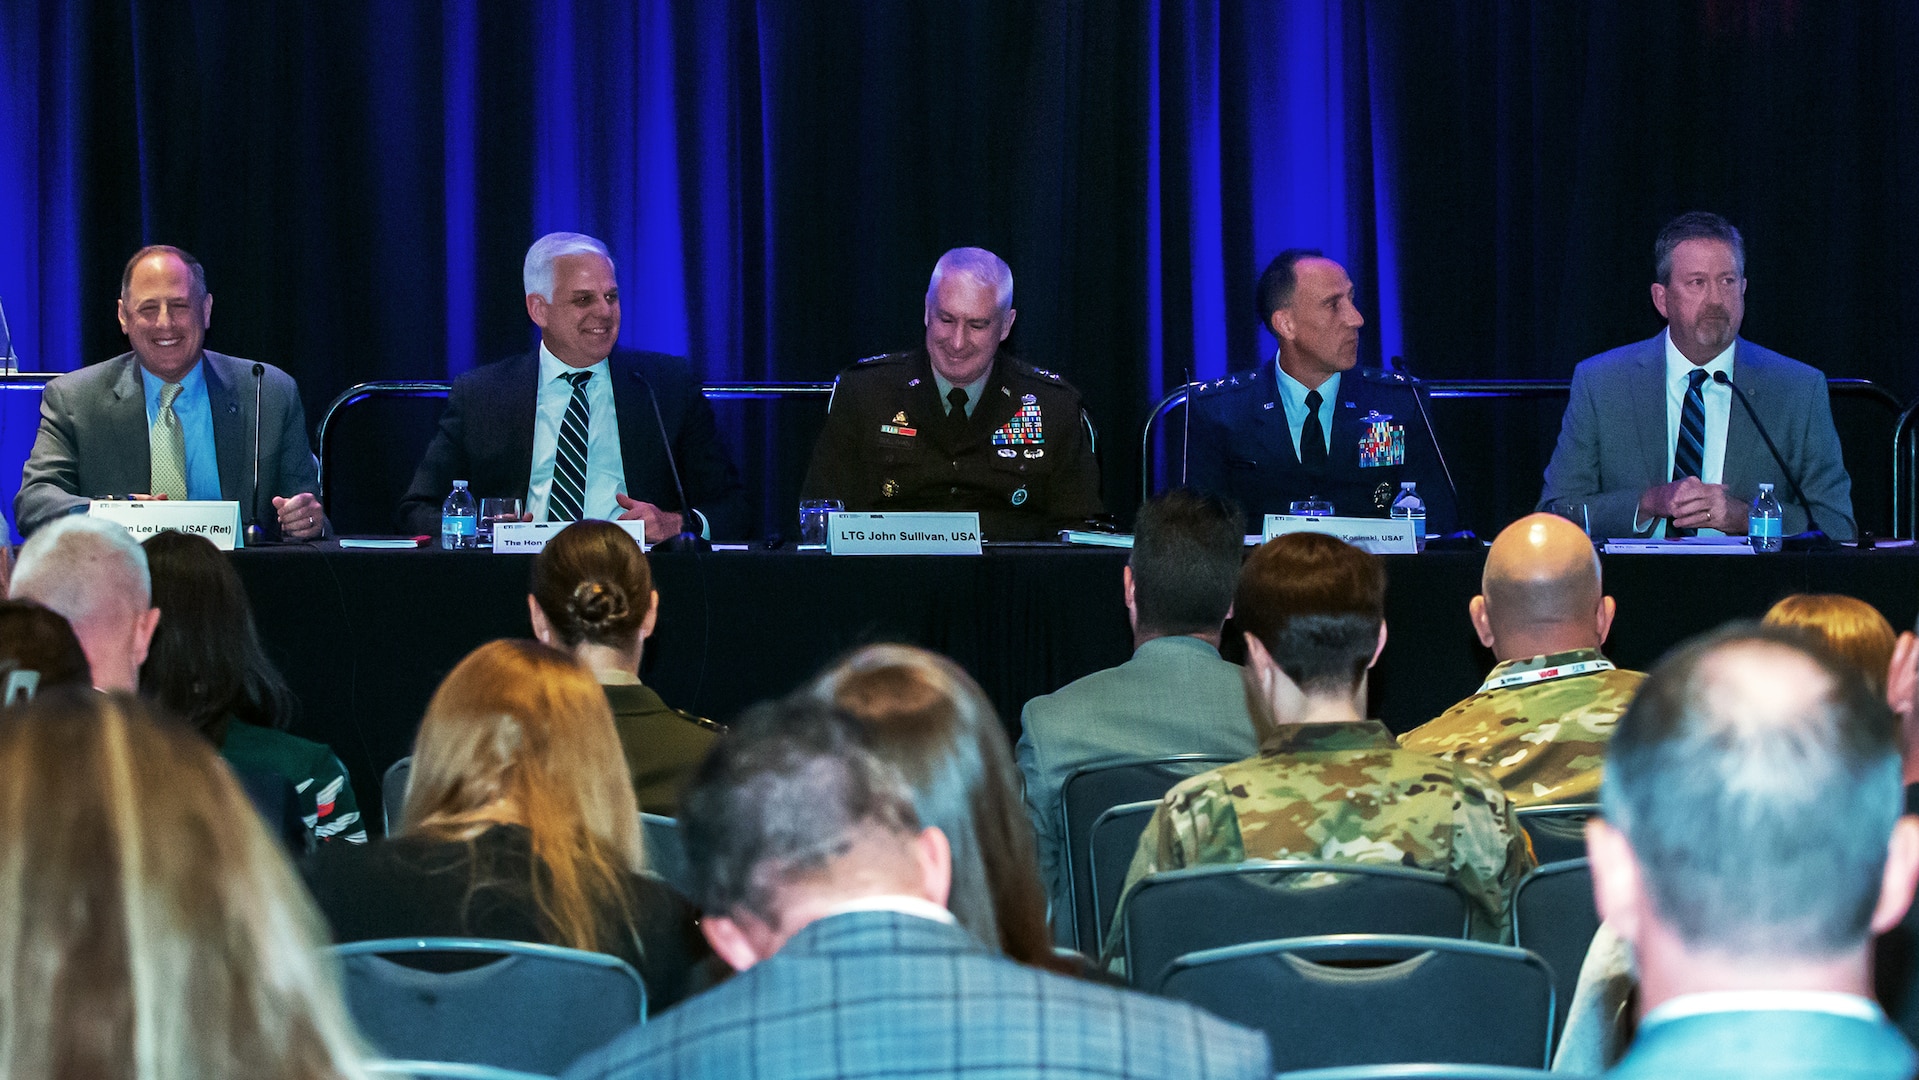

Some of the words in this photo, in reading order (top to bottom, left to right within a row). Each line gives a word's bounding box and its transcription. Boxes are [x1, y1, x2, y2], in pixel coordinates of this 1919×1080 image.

[182, 525, 208, 533] USAF
[210, 525, 232, 535] (Ret)
[841, 531, 865, 540] LTG
[868, 531, 896, 541] John
[900, 531, 948, 542] Sullivan,
[951, 532, 977, 541] USA
